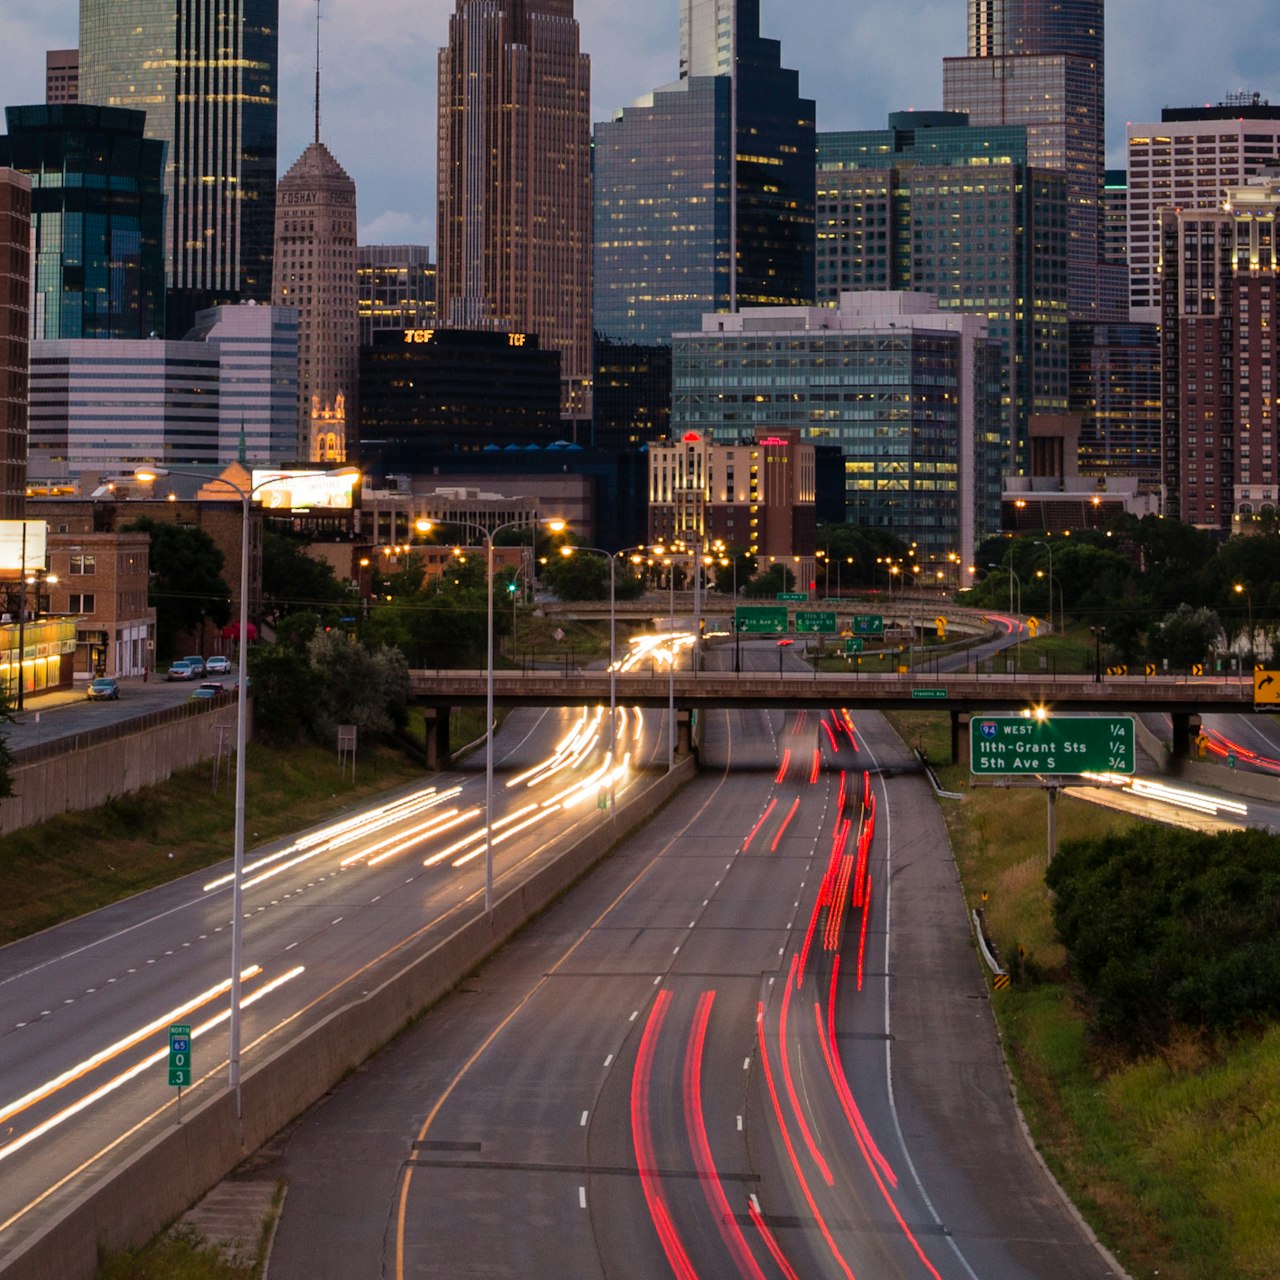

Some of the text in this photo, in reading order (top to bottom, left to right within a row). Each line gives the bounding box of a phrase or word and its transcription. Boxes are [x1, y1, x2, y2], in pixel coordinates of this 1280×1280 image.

[282, 192, 318, 204] FOSHAY
[330, 192, 353, 204] FOSHAY
[404, 330, 434, 343] TCF
[508, 333, 525, 346] TCF
[983, 726, 996, 734] 94
[1003, 726, 1033, 734] WEST
[980, 742, 1056, 752] 11th-Grant
[1064, 742, 1087, 752] Sts
[980, 757, 1005, 768] 5th
[1013, 758, 1039, 768] Ave
[1047, 758, 1056, 768] S
[174, 1041, 185, 1050] 65
[176, 1054, 184, 1066] 0
